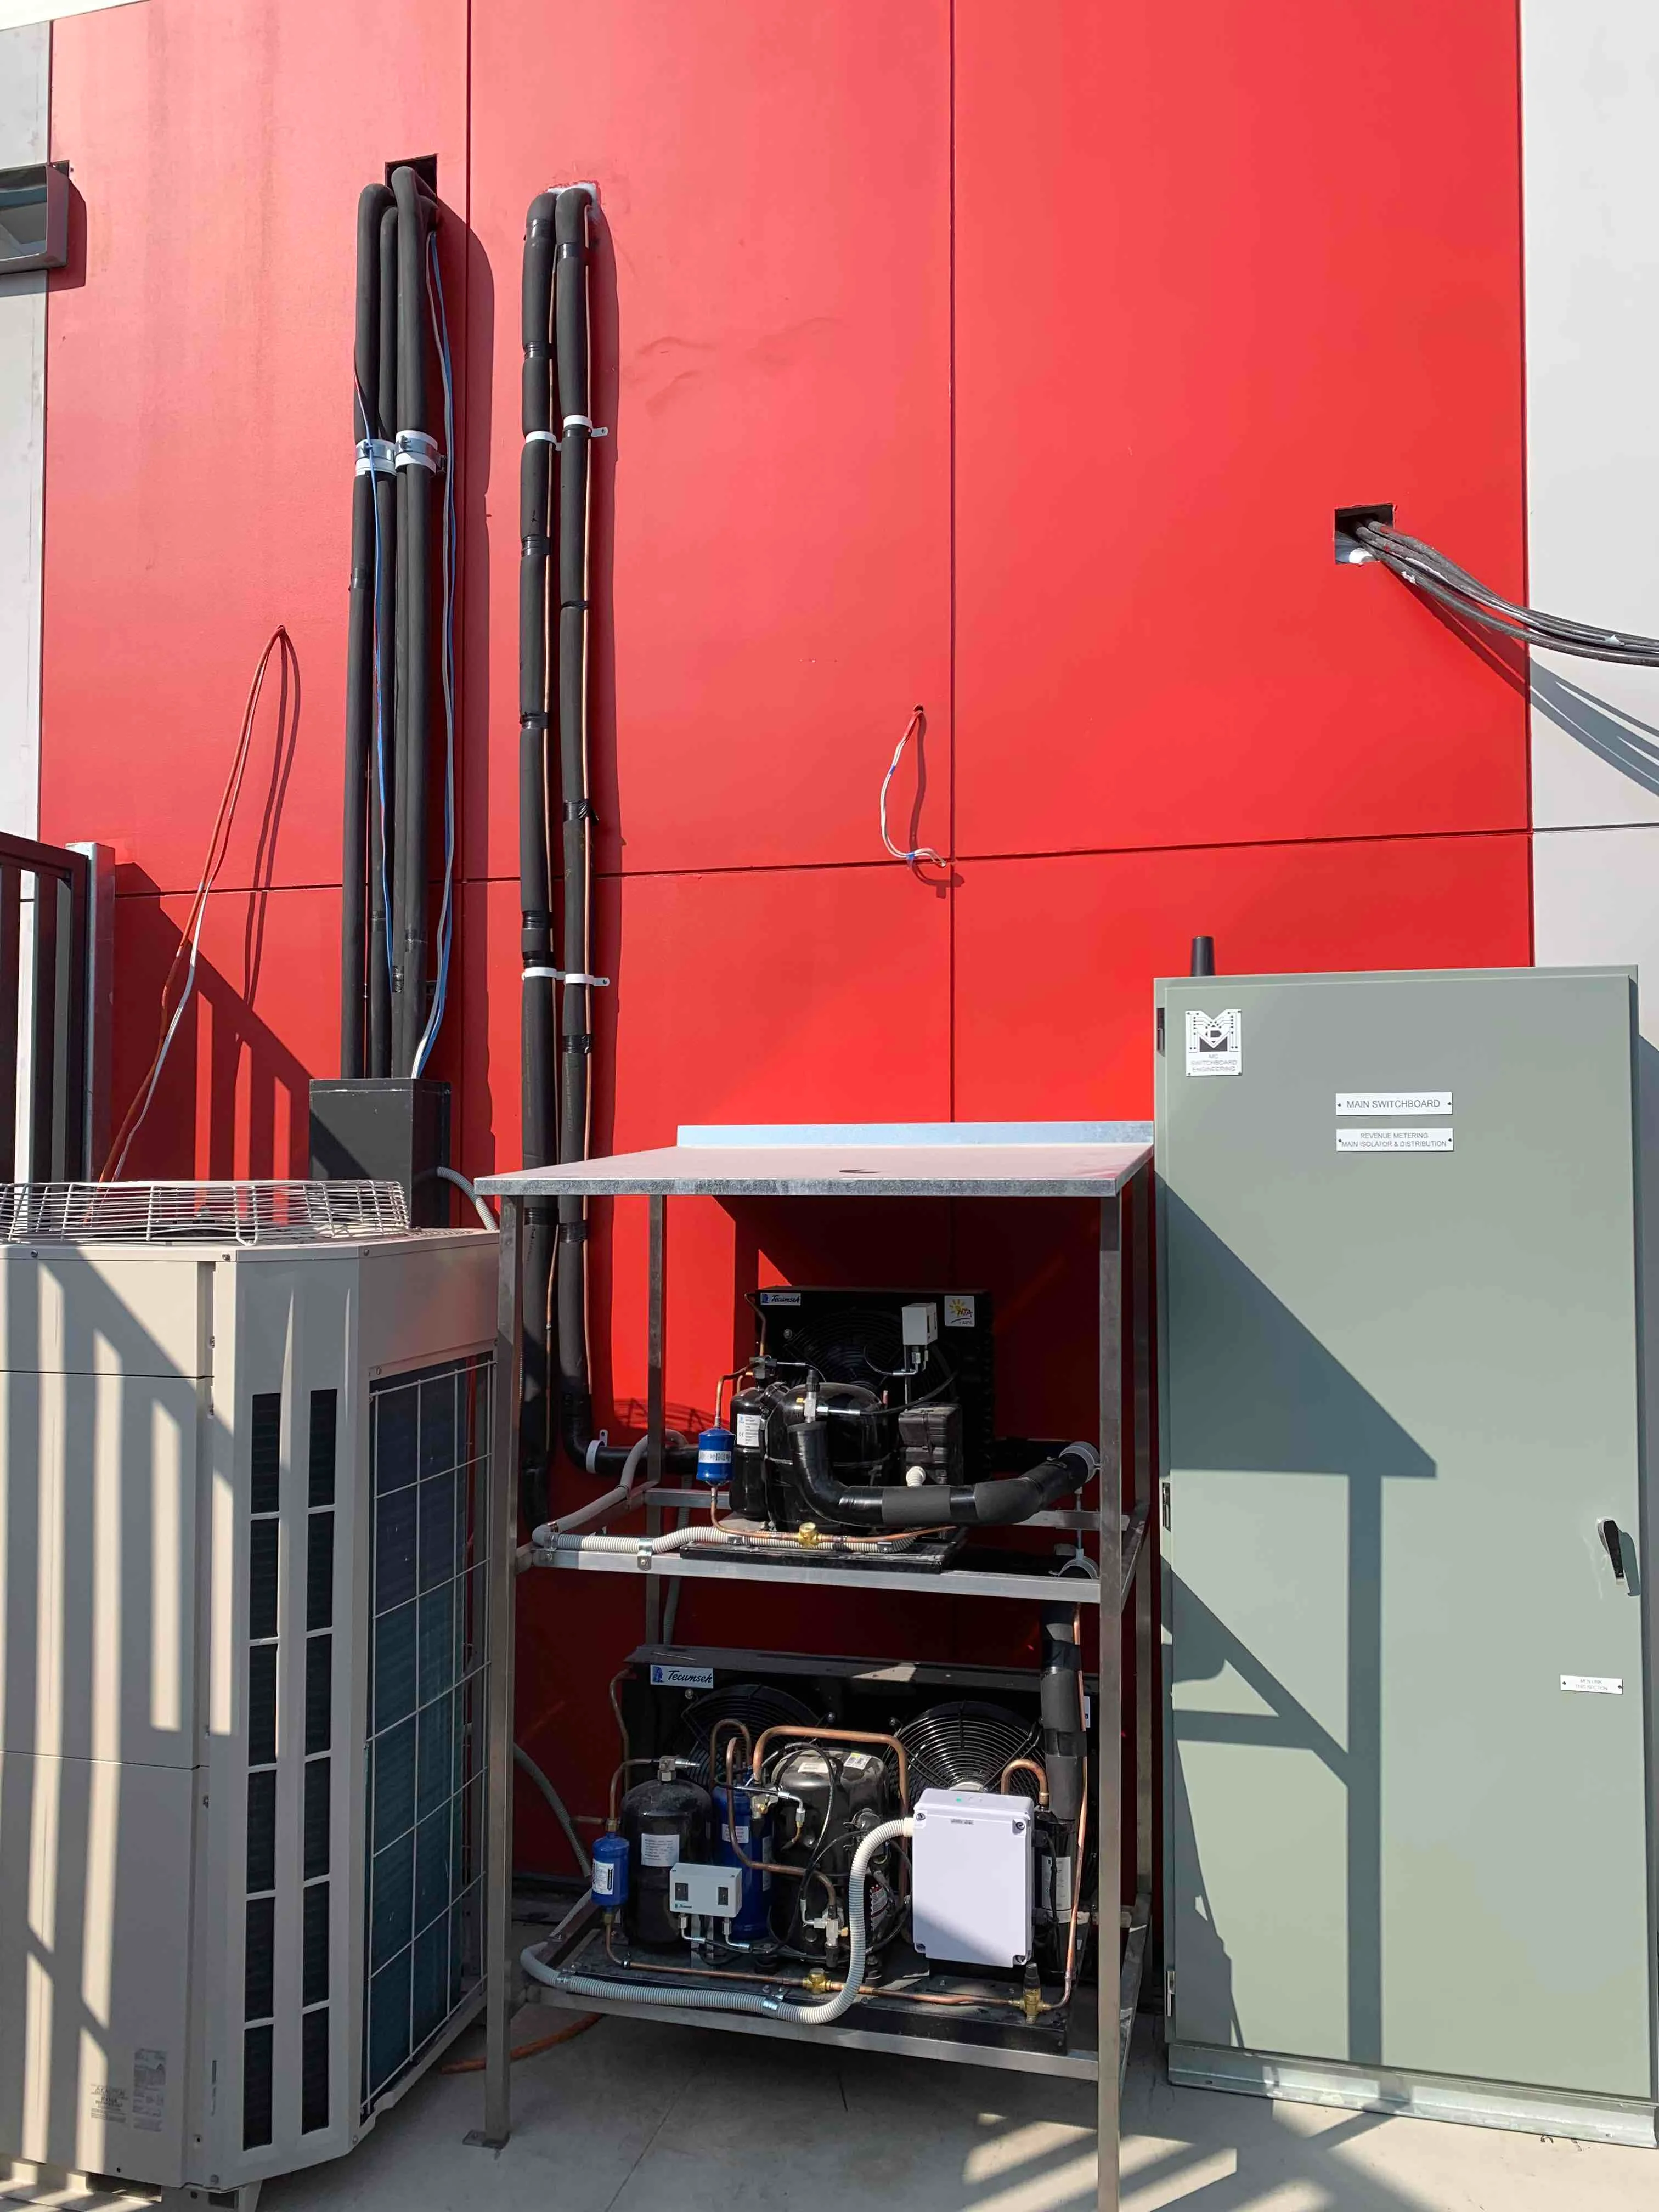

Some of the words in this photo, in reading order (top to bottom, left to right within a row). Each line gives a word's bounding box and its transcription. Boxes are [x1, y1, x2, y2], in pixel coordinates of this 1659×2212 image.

[1372, 1099, 1440, 1108] SWITCHBOARD
[771, 1295, 800, 1303] Tecumseh
[668, 1669, 713, 1683] Tecumseh
